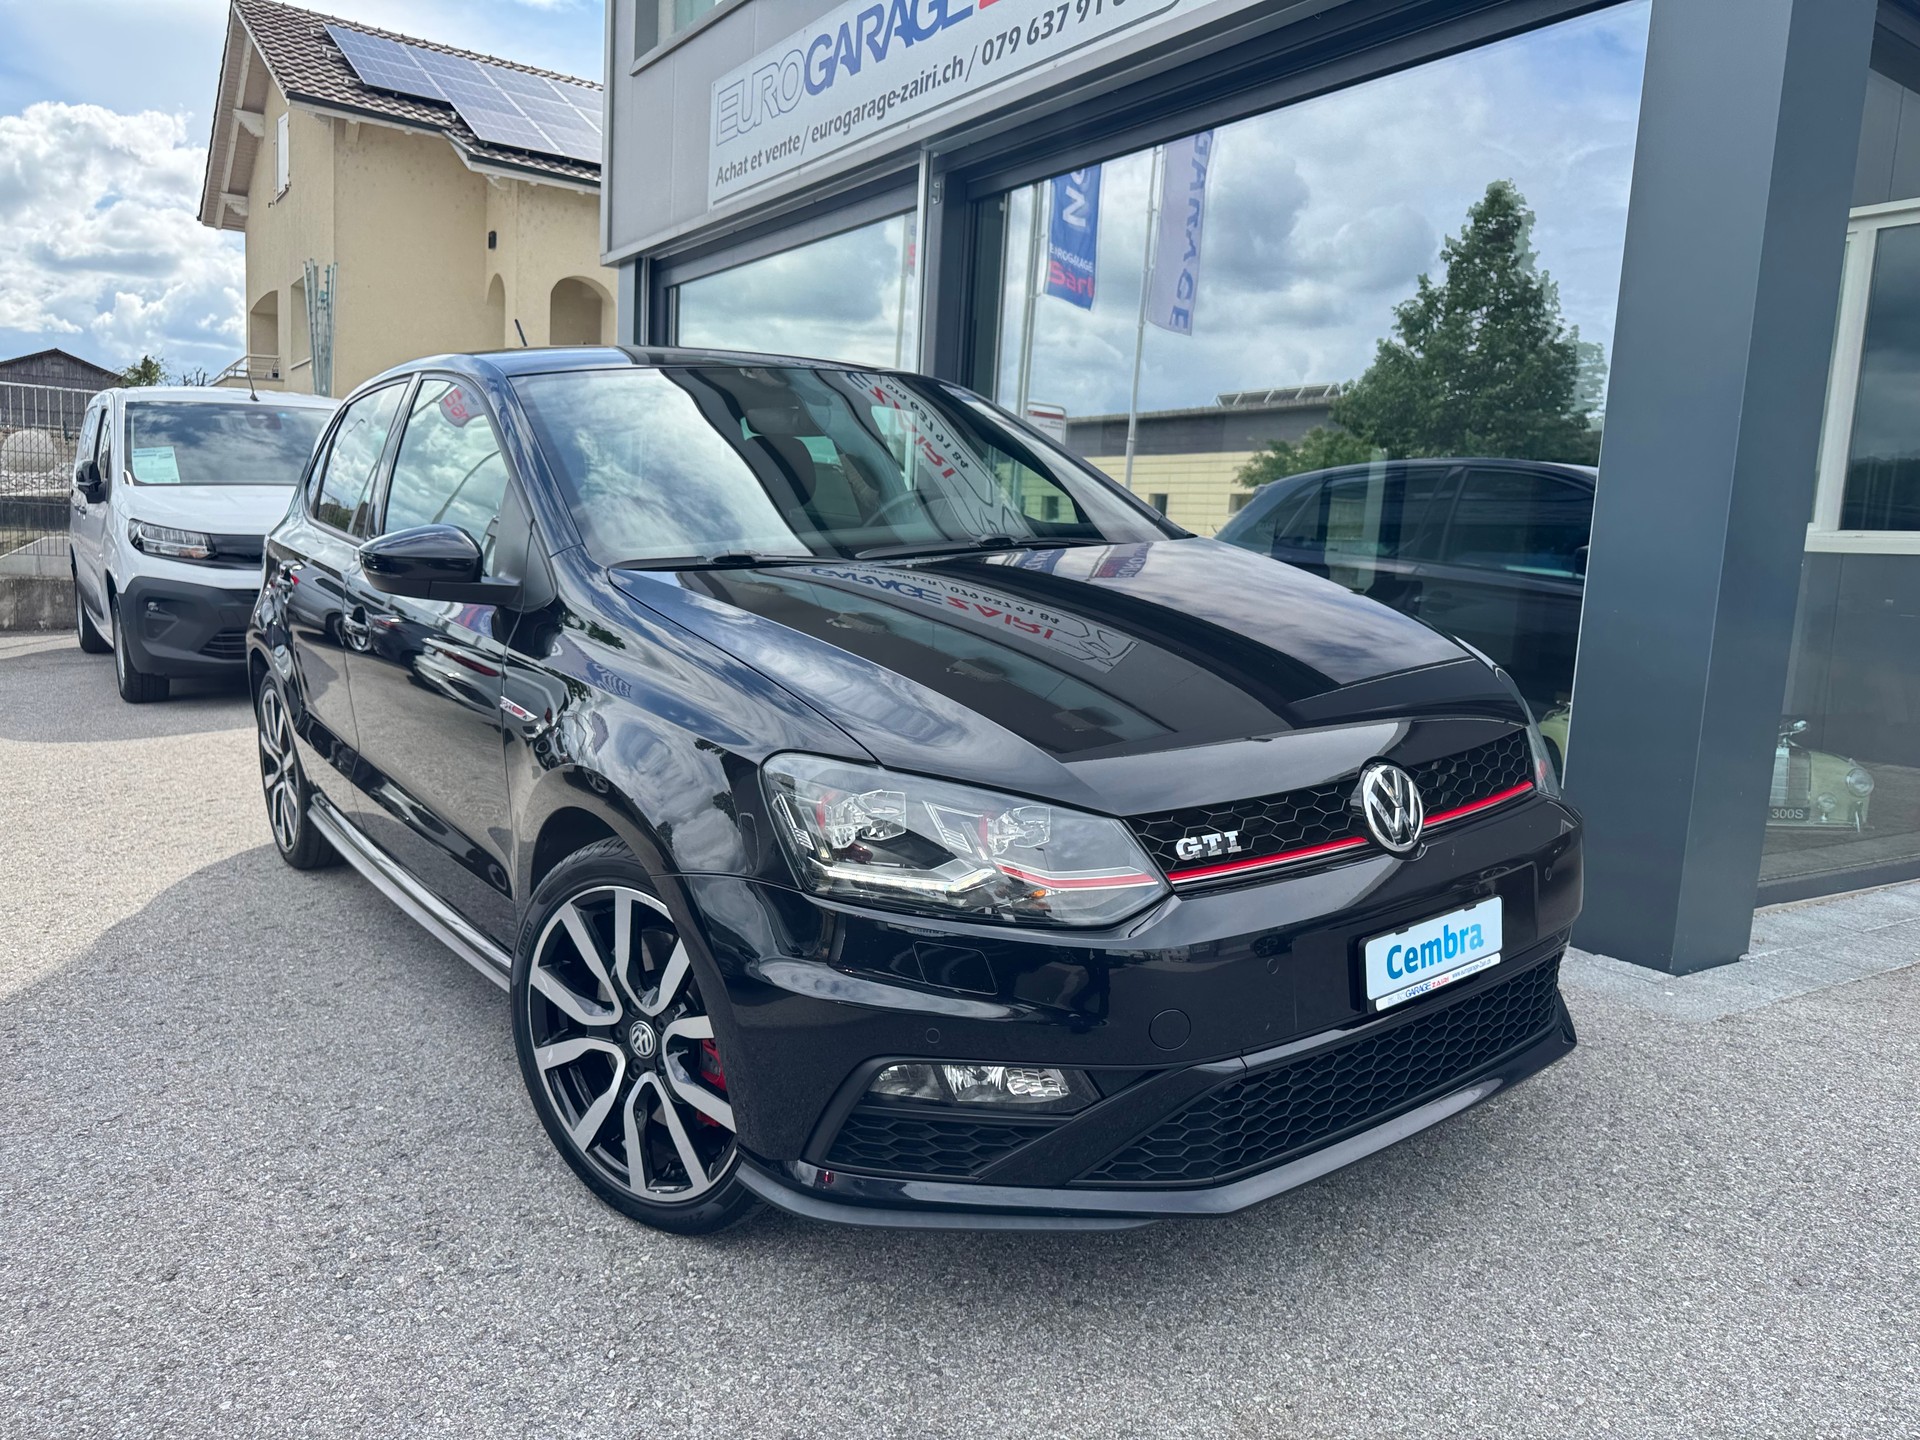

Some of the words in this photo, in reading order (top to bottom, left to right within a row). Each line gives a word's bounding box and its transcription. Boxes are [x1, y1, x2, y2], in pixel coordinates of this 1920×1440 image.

[716, 158, 748, 187] Achat
[750, 149, 763, 171] et
[764, 134, 800, 165] vente
[811, 55, 964, 144] eurogarage-zairi.ch
[981, 26, 1021, 66] 079
[1026, 2, 1070, 46] 637
[1771, 808, 1804, 819] 300S
[1175, 831, 1242, 860] GTI
[1386, 924, 1484, 979] Cembra
